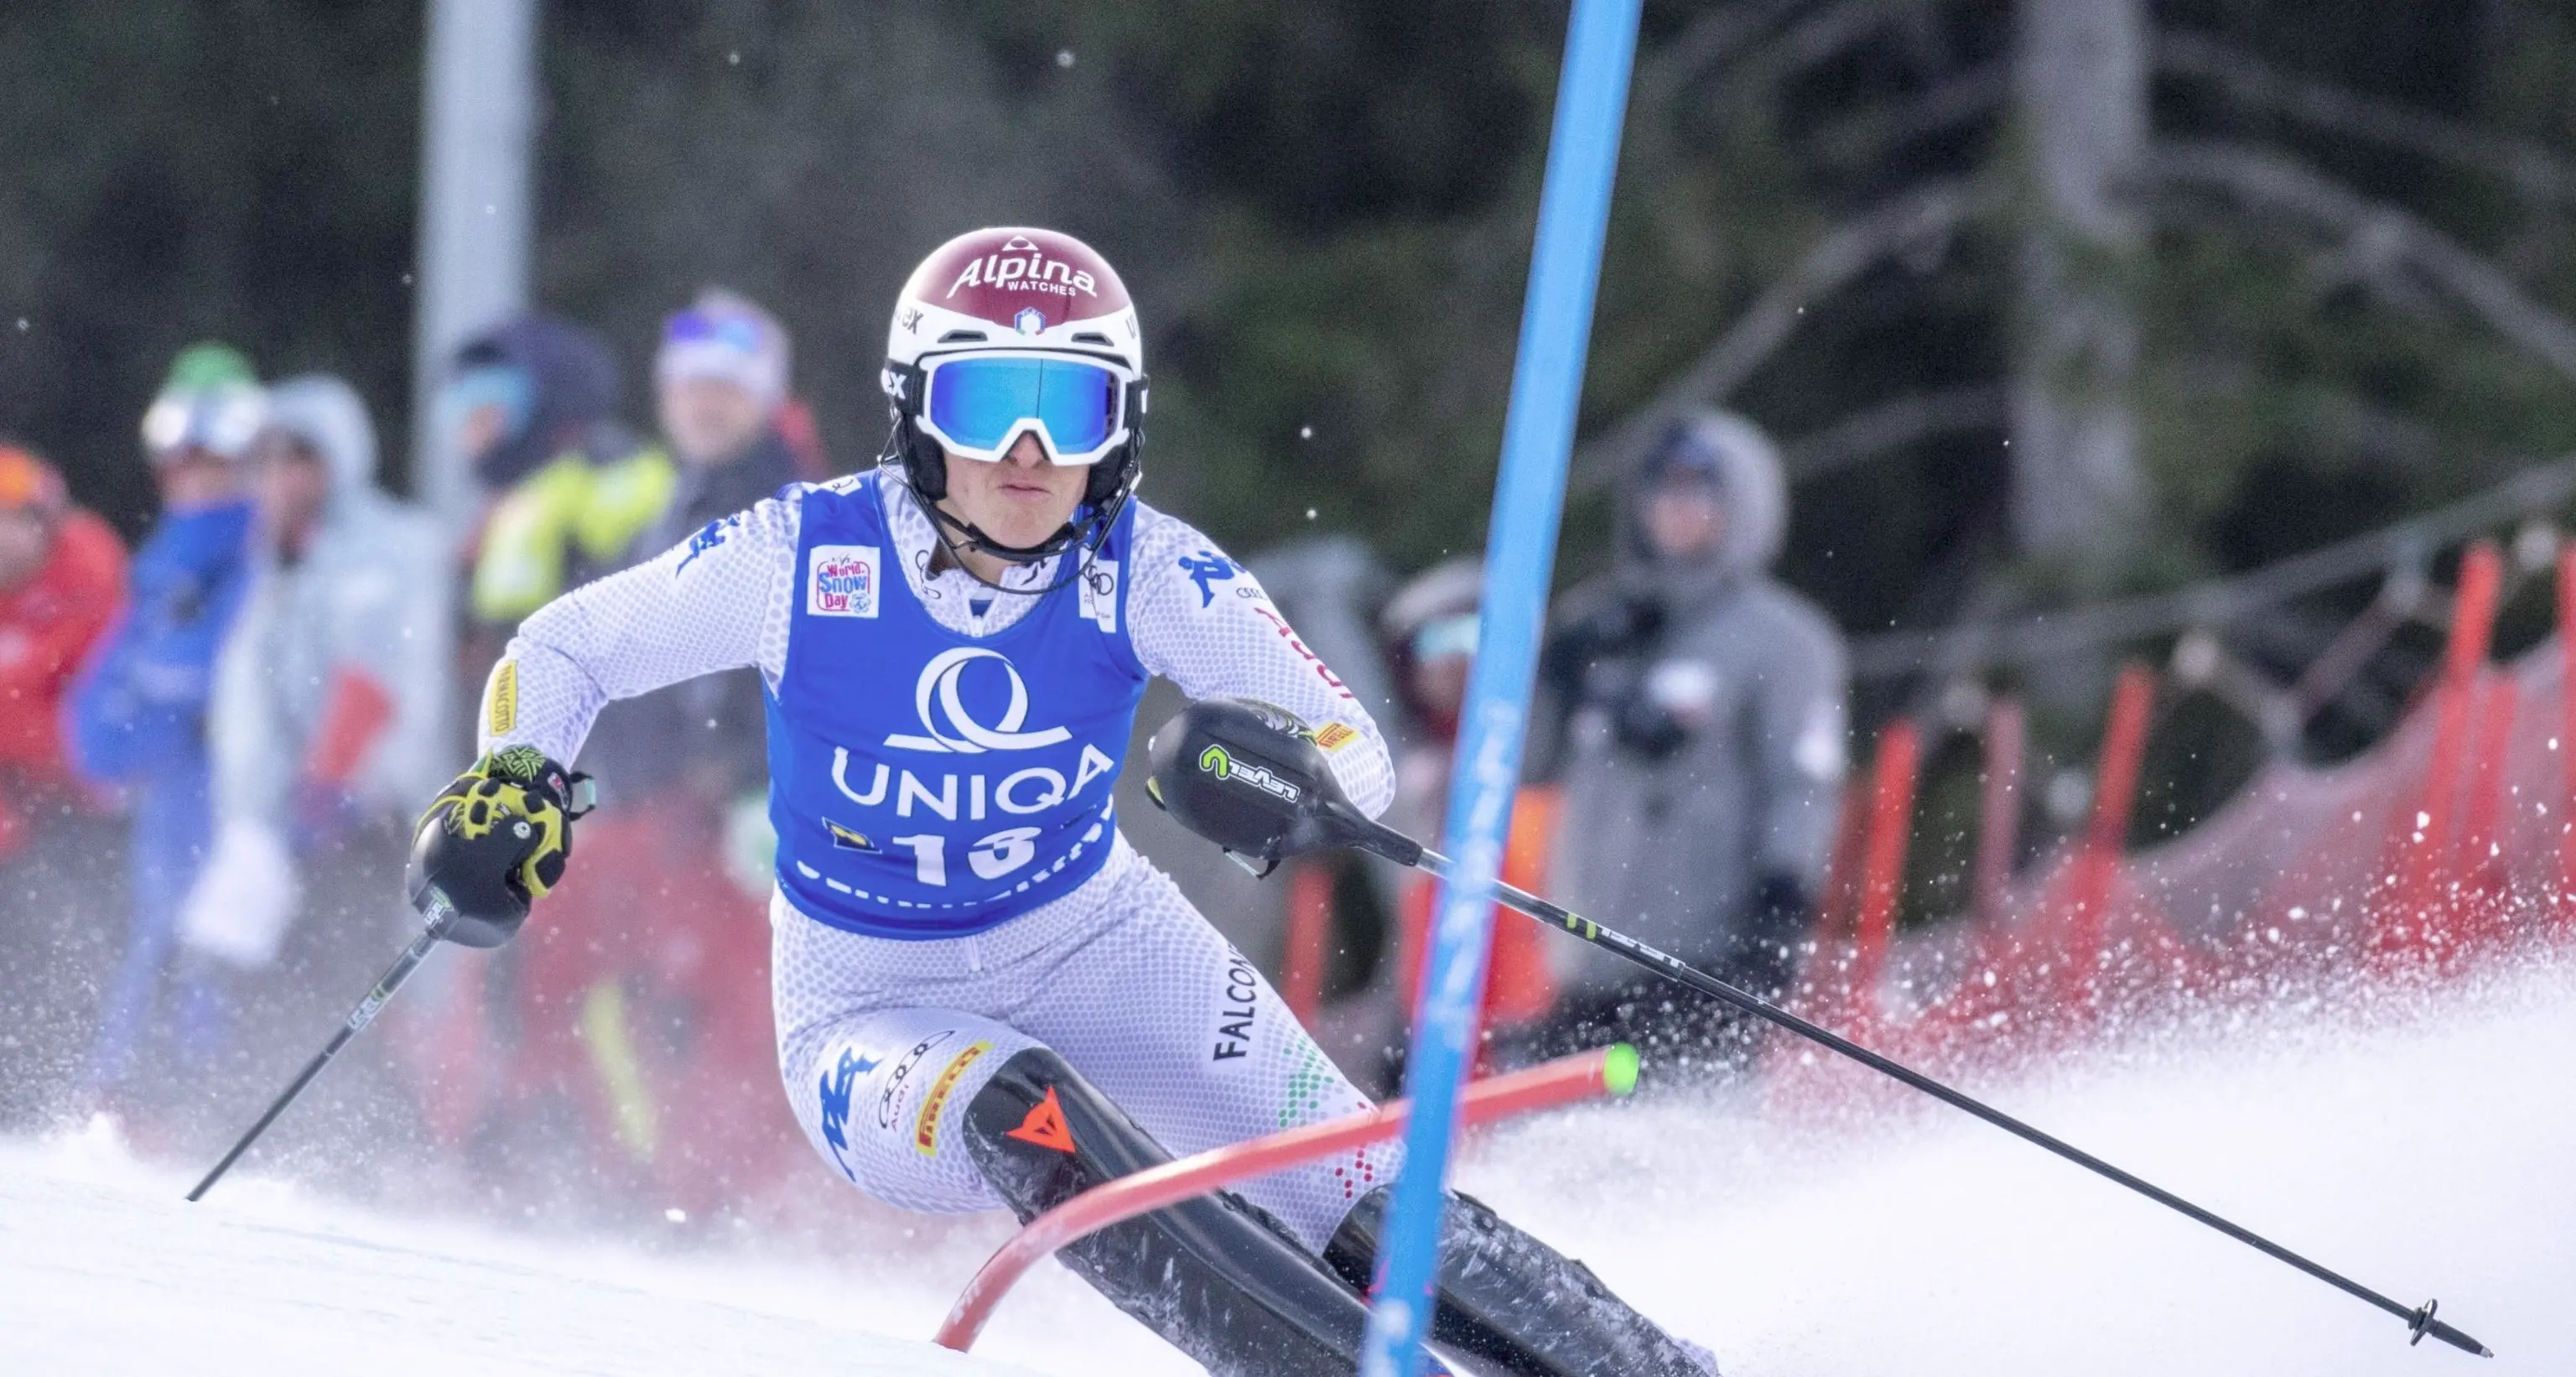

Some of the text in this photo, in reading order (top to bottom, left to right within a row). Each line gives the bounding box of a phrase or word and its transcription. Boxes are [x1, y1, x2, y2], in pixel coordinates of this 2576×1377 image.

[946, 253, 1098, 299] Alpina
[1008, 281, 1077, 297] WATCHES
[827, 564, 861, 578] World
[818, 572, 867, 593] Snow
[824, 594, 849, 610] Day
[832, 743, 1114, 821] UNIQA
[1230, 764, 1298, 800] LEVEL
